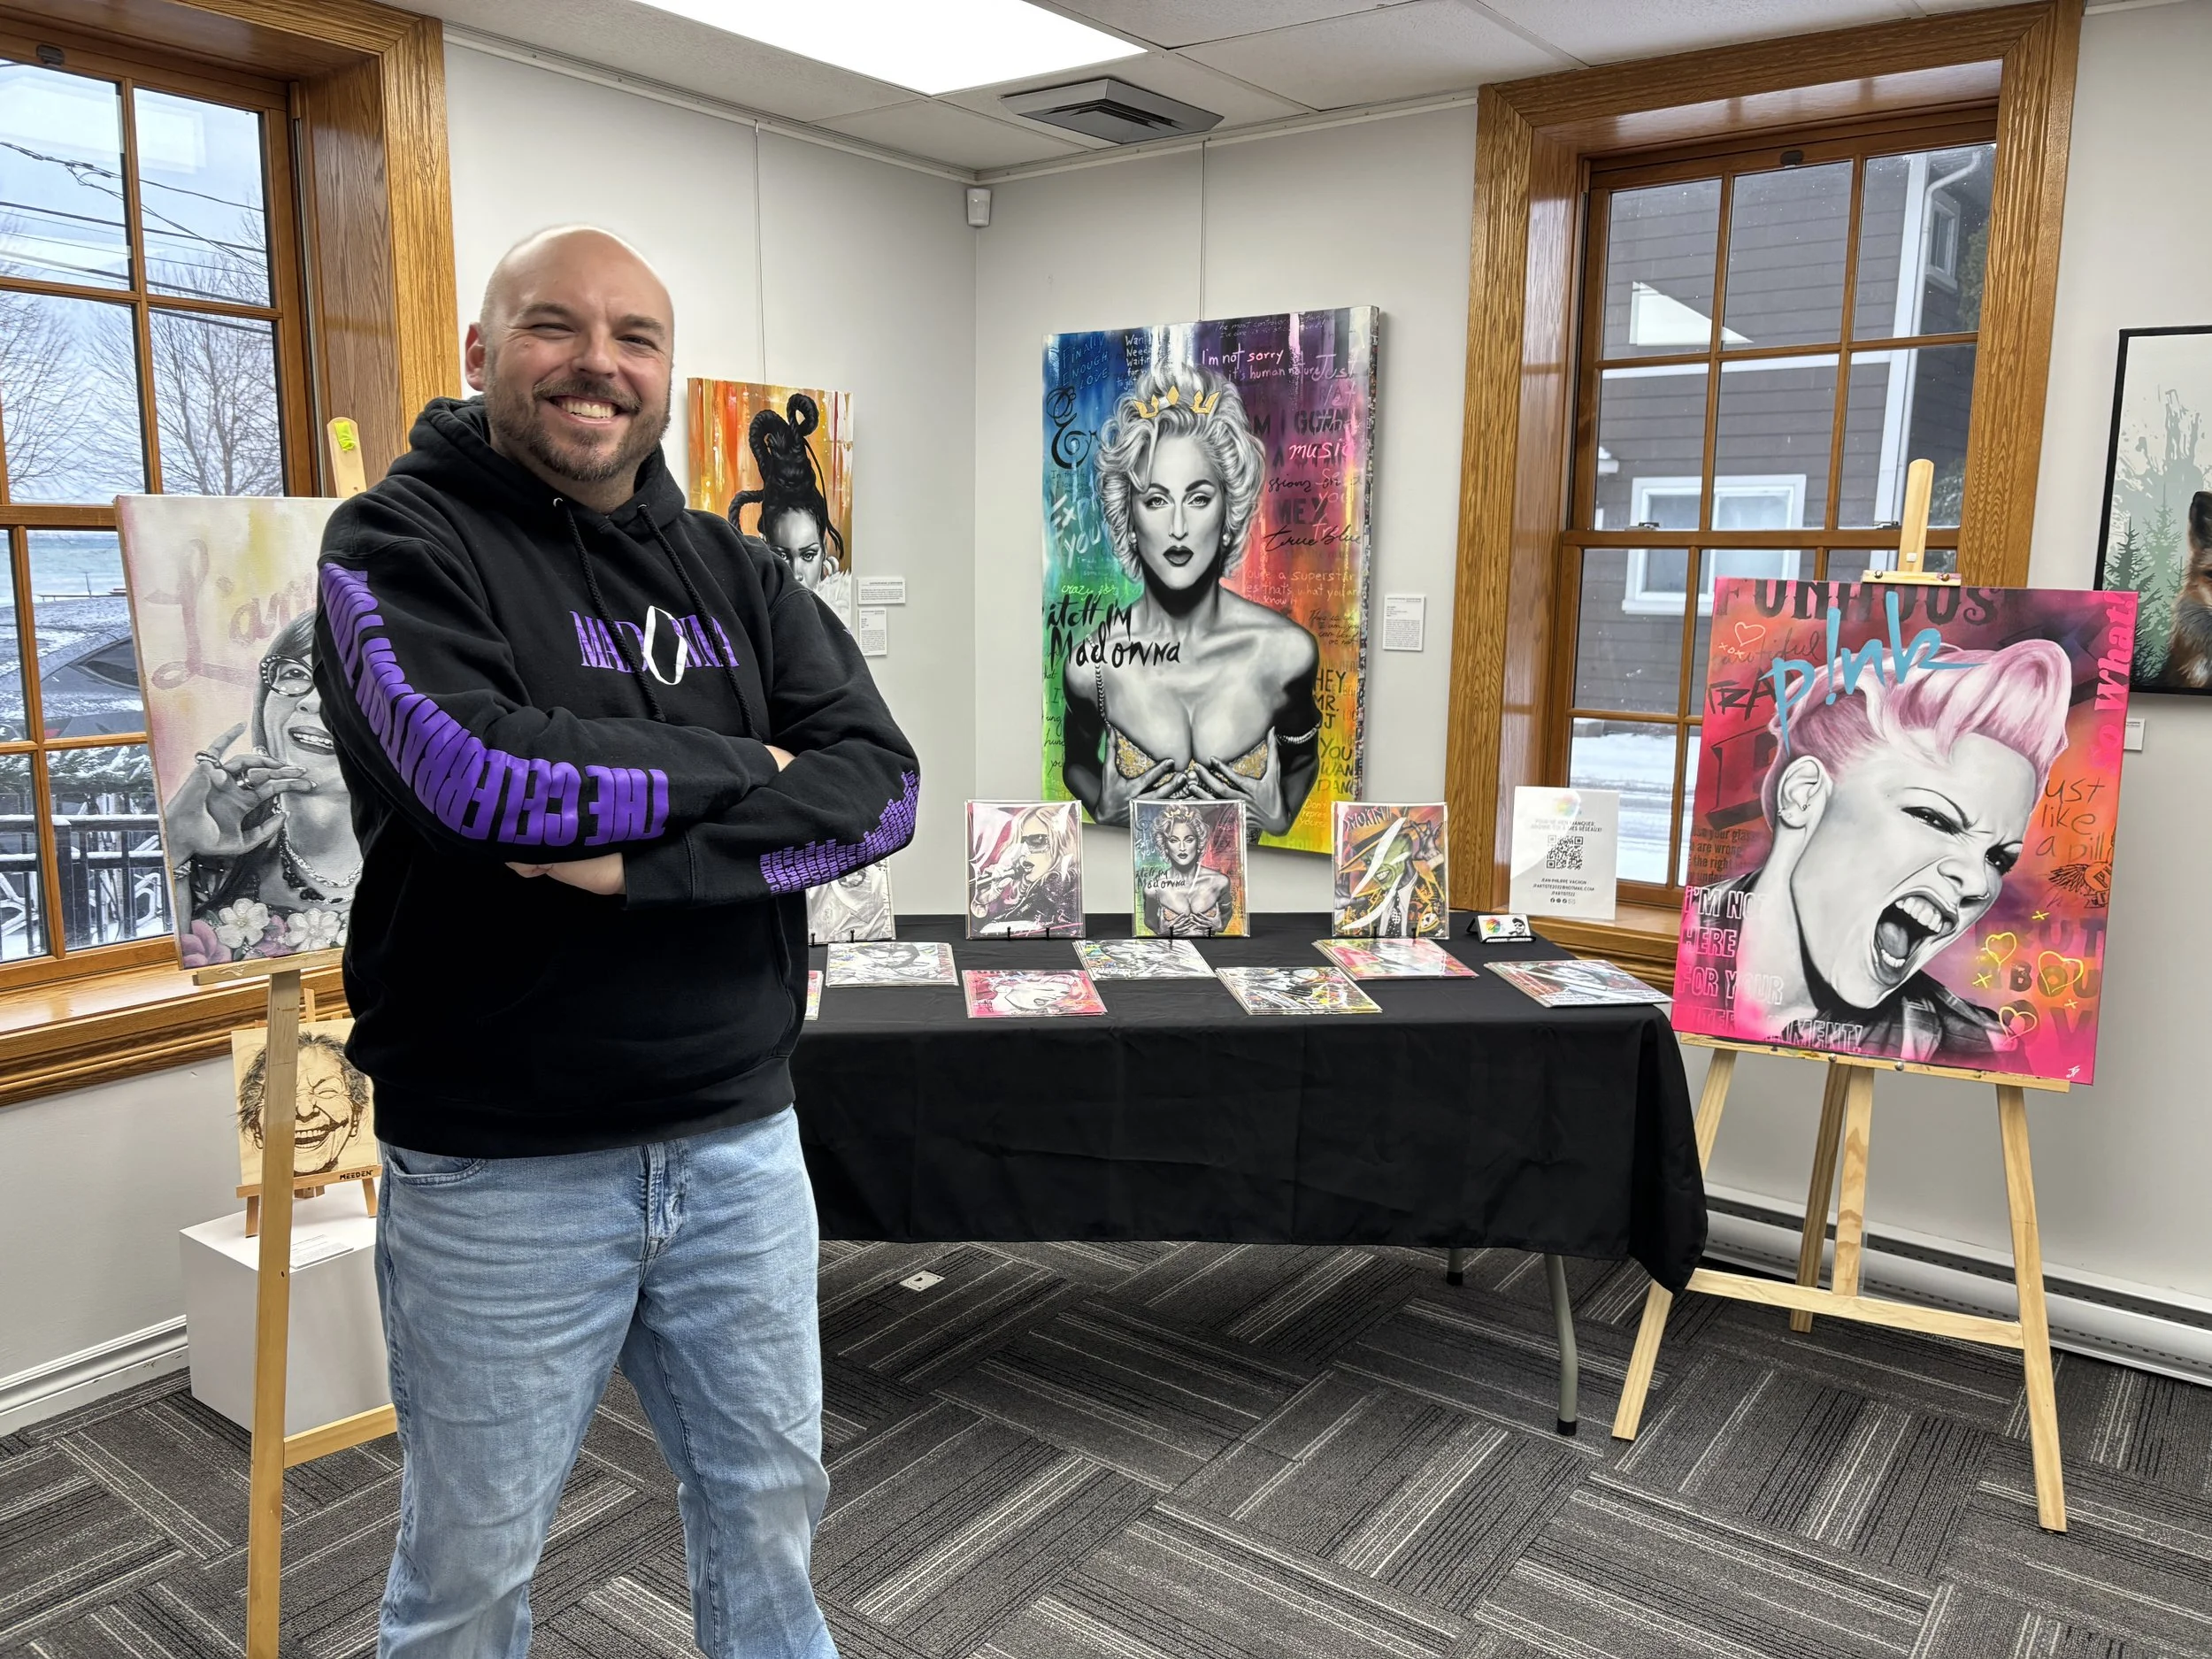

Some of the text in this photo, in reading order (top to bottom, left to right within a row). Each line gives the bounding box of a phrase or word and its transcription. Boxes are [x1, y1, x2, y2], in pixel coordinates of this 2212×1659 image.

[1202, 342, 1285, 370] I'm not sorry
[1248, 365, 1286, 381] human
[1288, 437, 1355, 460] music
[1263, 523, 1362, 552] true blue
[1290, 568, 1356, 584] superstar
[1061, 584, 1094, 601] crazy
[2093, 591, 2136, 711] What!
[1314, 668, 1347, 694] HEY
[1319, 736, 1354, 762] YOU
[584, 764, 670, 847] THE
[2041, 803, 2096, 835] like
[1693, 856, 1708, 868] the
[1715, 844, 1741, 858] wrong
[759, 853, 776, 884] MEXICO
[1684, 885, 1721, 918] I'M
[1682, 926, 1738, 958] HERE
[339, 1169, 373, 1180] MEEDEN
